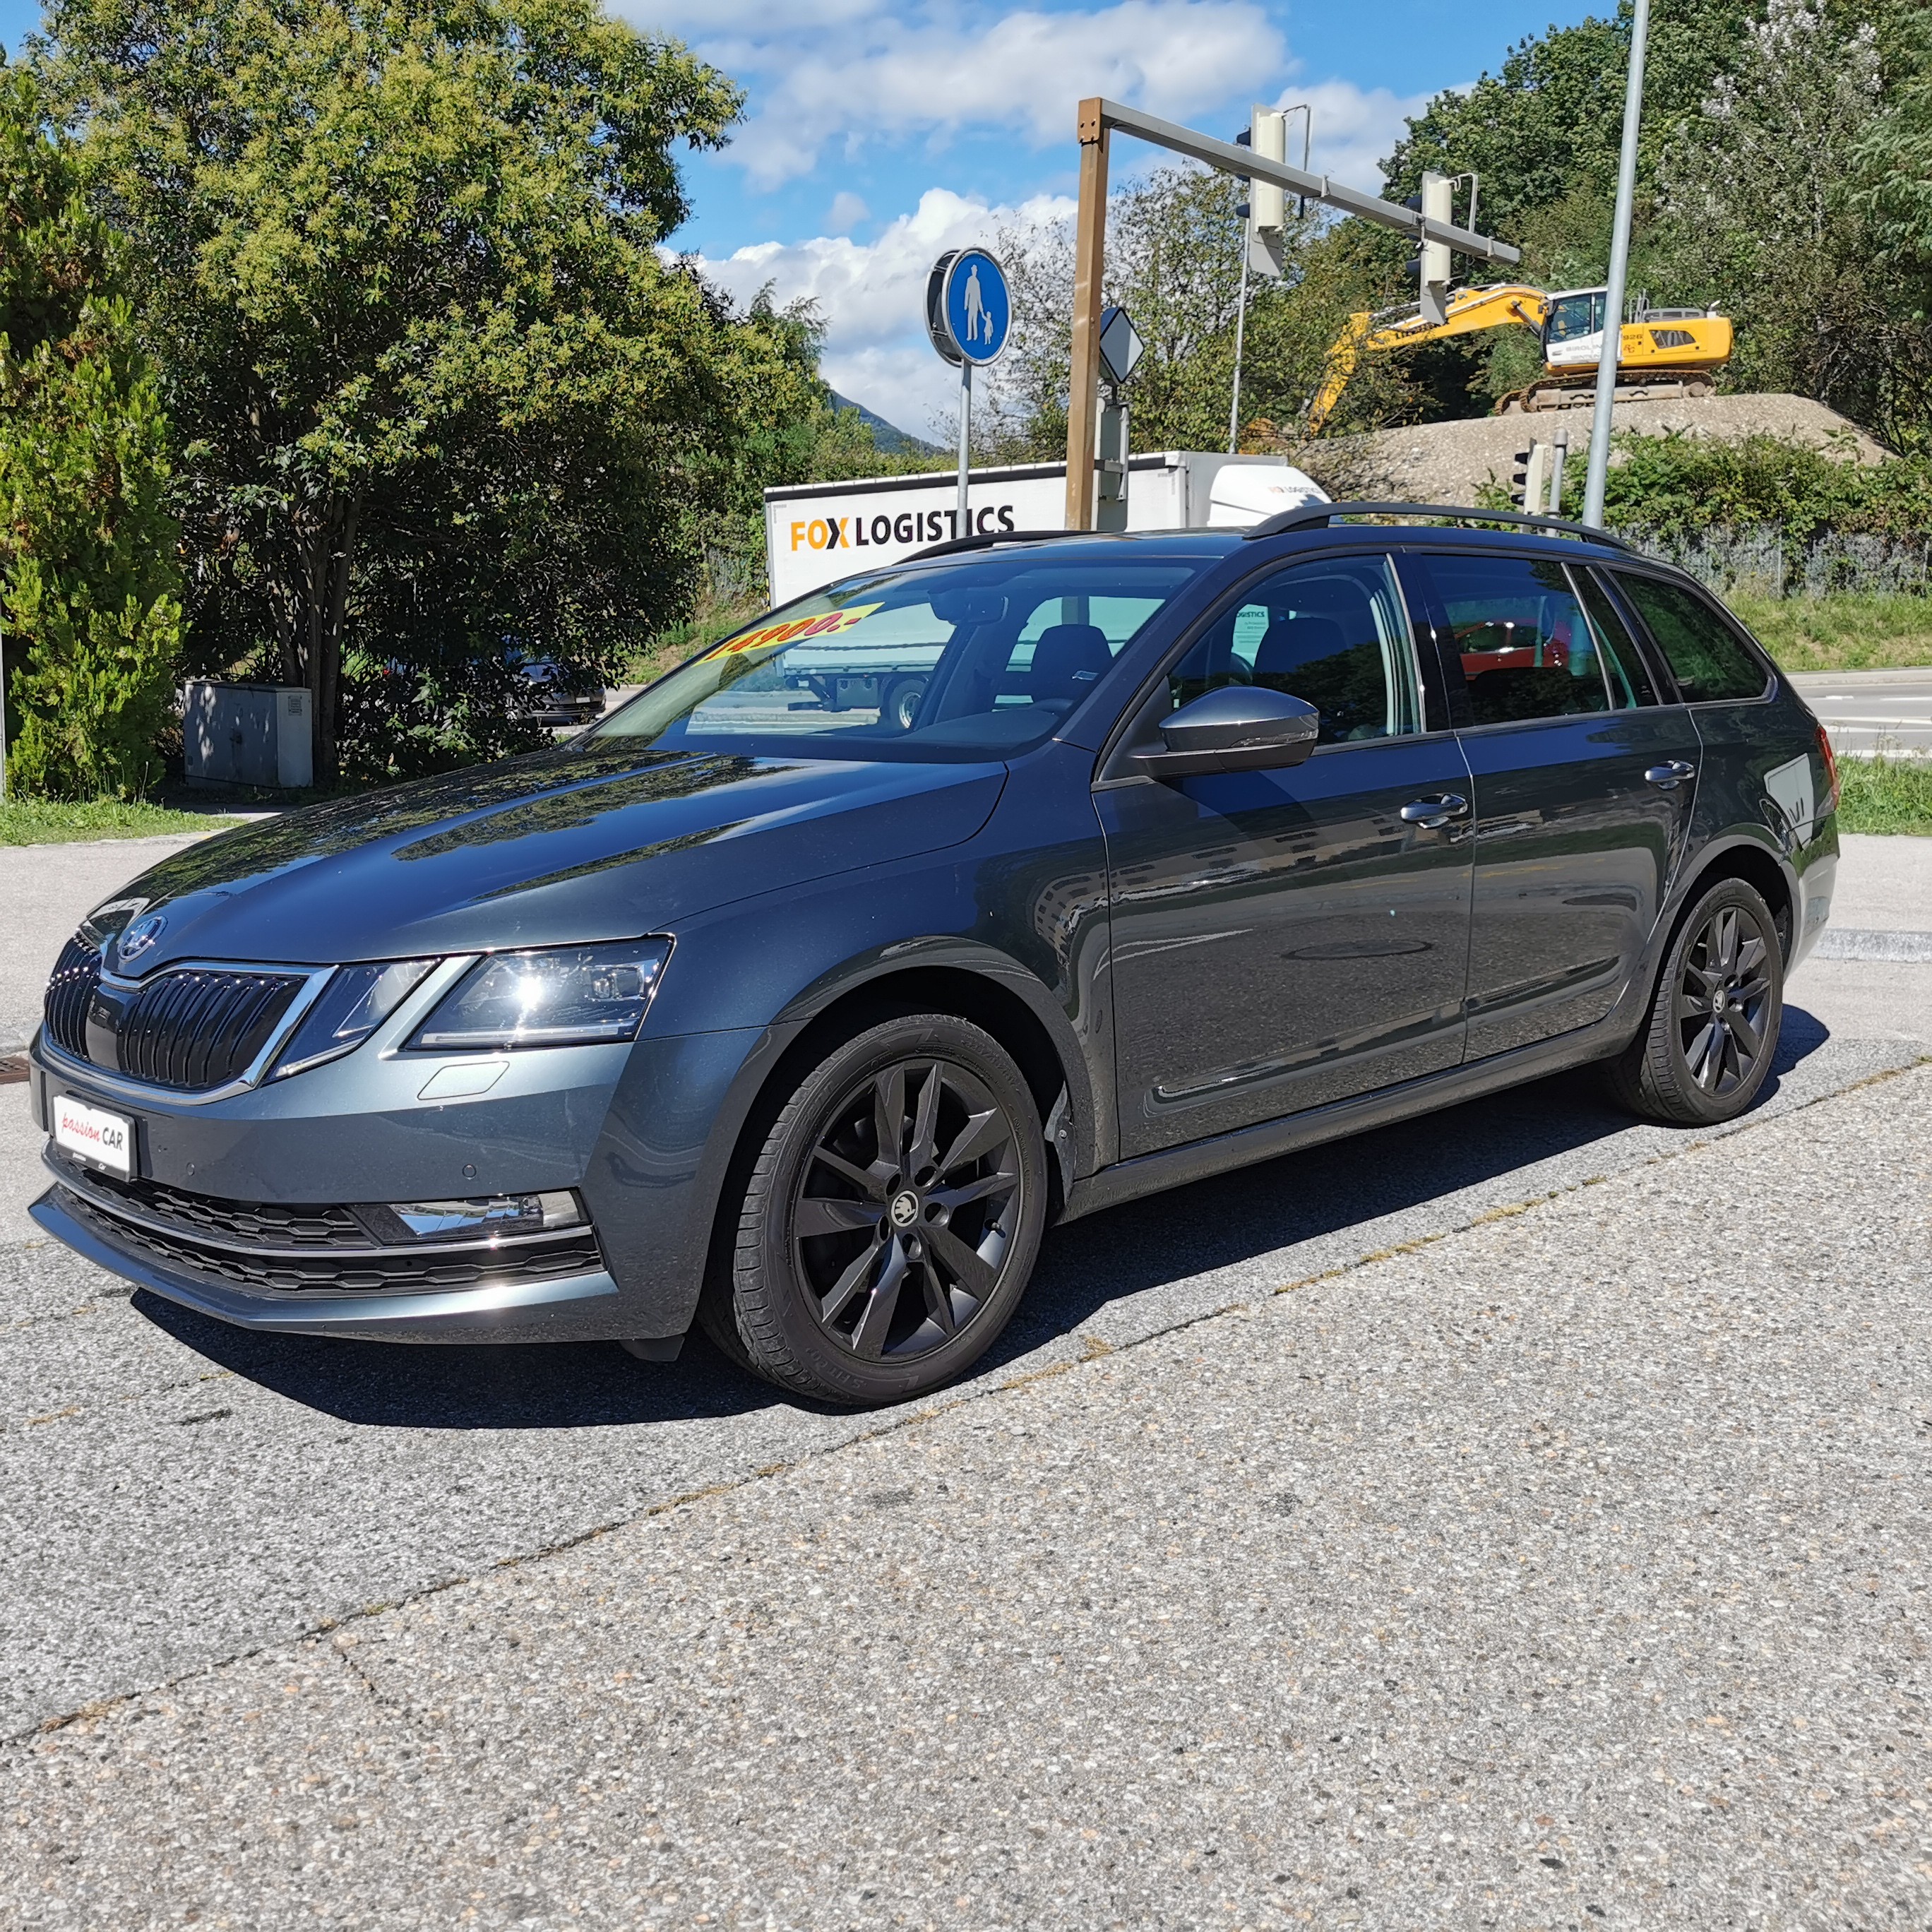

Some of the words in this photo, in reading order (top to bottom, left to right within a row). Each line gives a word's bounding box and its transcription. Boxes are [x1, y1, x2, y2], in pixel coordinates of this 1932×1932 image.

[791, 517, 850, 551] FOX
[856, 505, 1015, 547] LOGISTICS
[61, 1111, 100, 1142] passion
[102, 1126, 124, 1151] CAR
